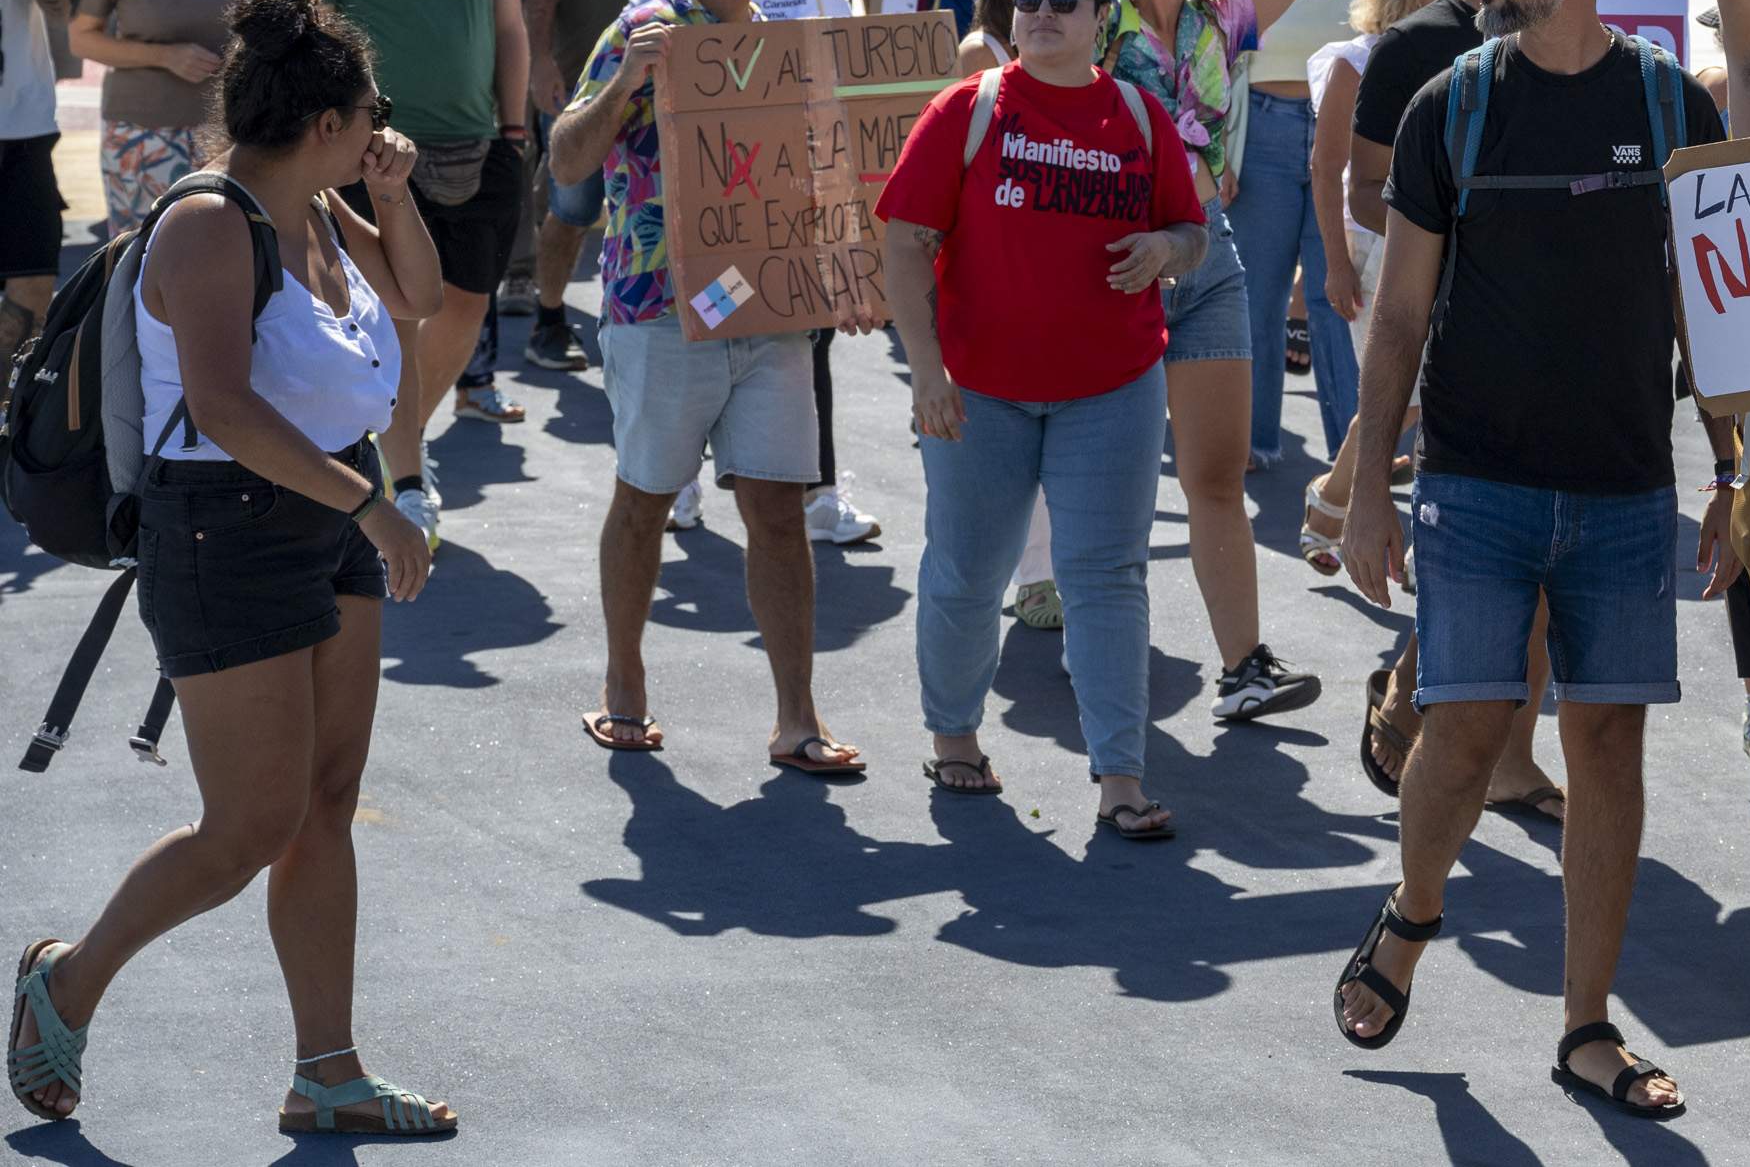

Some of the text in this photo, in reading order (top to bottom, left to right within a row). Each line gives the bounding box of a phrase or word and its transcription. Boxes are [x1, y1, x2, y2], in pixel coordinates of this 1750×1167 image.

[777, 48, 814, 86] AL
[821, 20, 960, 80] TURISMO
[773, 142, 794, 177] A
[808, 120, 847, 171] LA
[1001, 131, 1122, 173] Manifiesto
[1612, 145, 1642, 157] VANS
[994, 178, 1026, 208] de
[698, 199, 878, 251] QUE EXPLOTA
